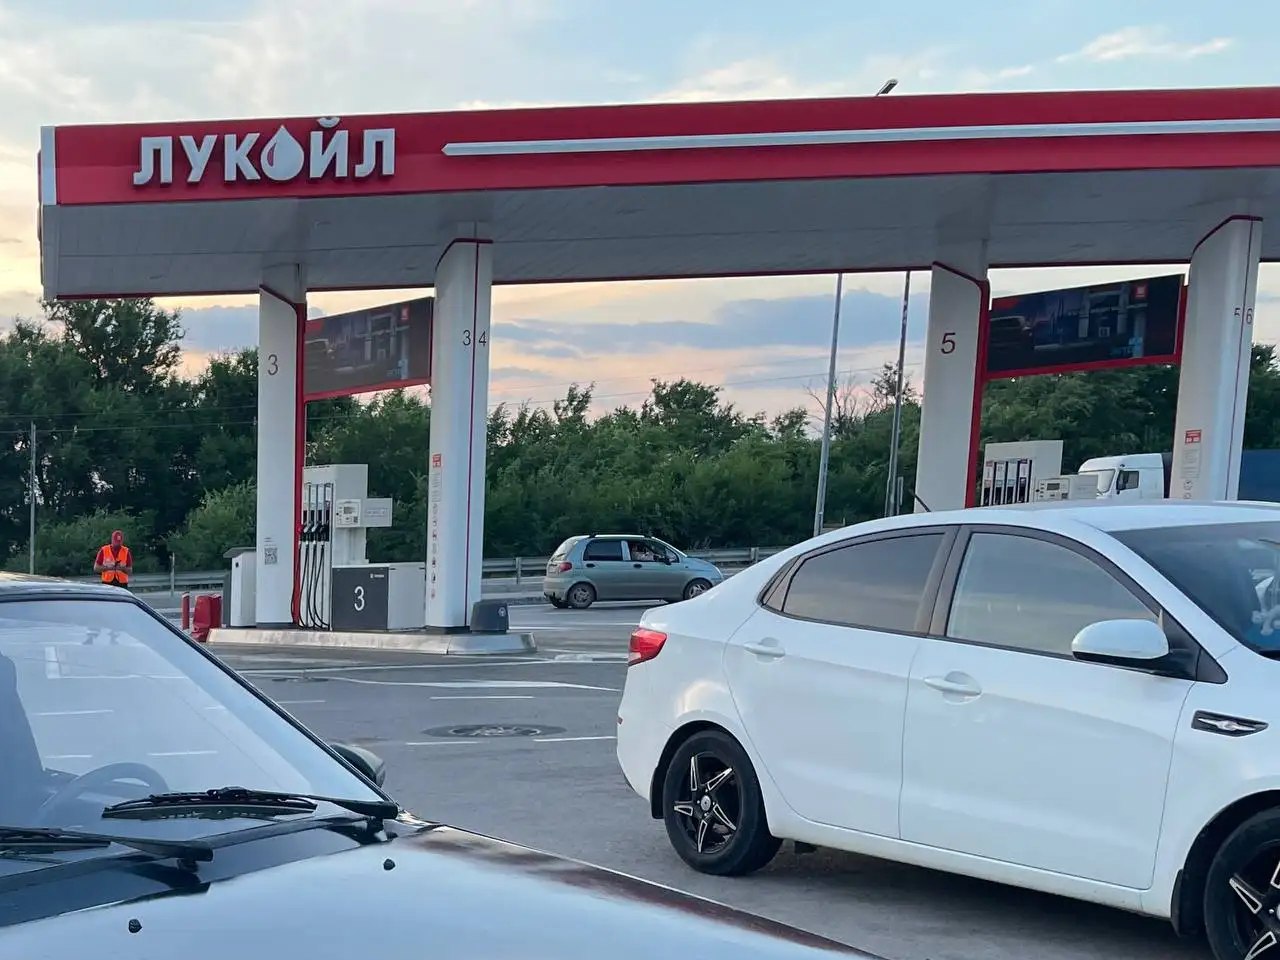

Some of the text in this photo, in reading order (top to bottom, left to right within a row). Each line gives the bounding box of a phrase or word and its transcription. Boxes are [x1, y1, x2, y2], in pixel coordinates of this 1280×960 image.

[132, 116, 396, 185] ЛУКОЙЛ
[1246, 308, 1253, 324] 6
[463, 330, 471, 346] 3
[478, 331, 487, 347] 4
[940, 332, 956, 354] 5
[267, 354, 279, 376] 3
[354, 586, 365, 611] 3
